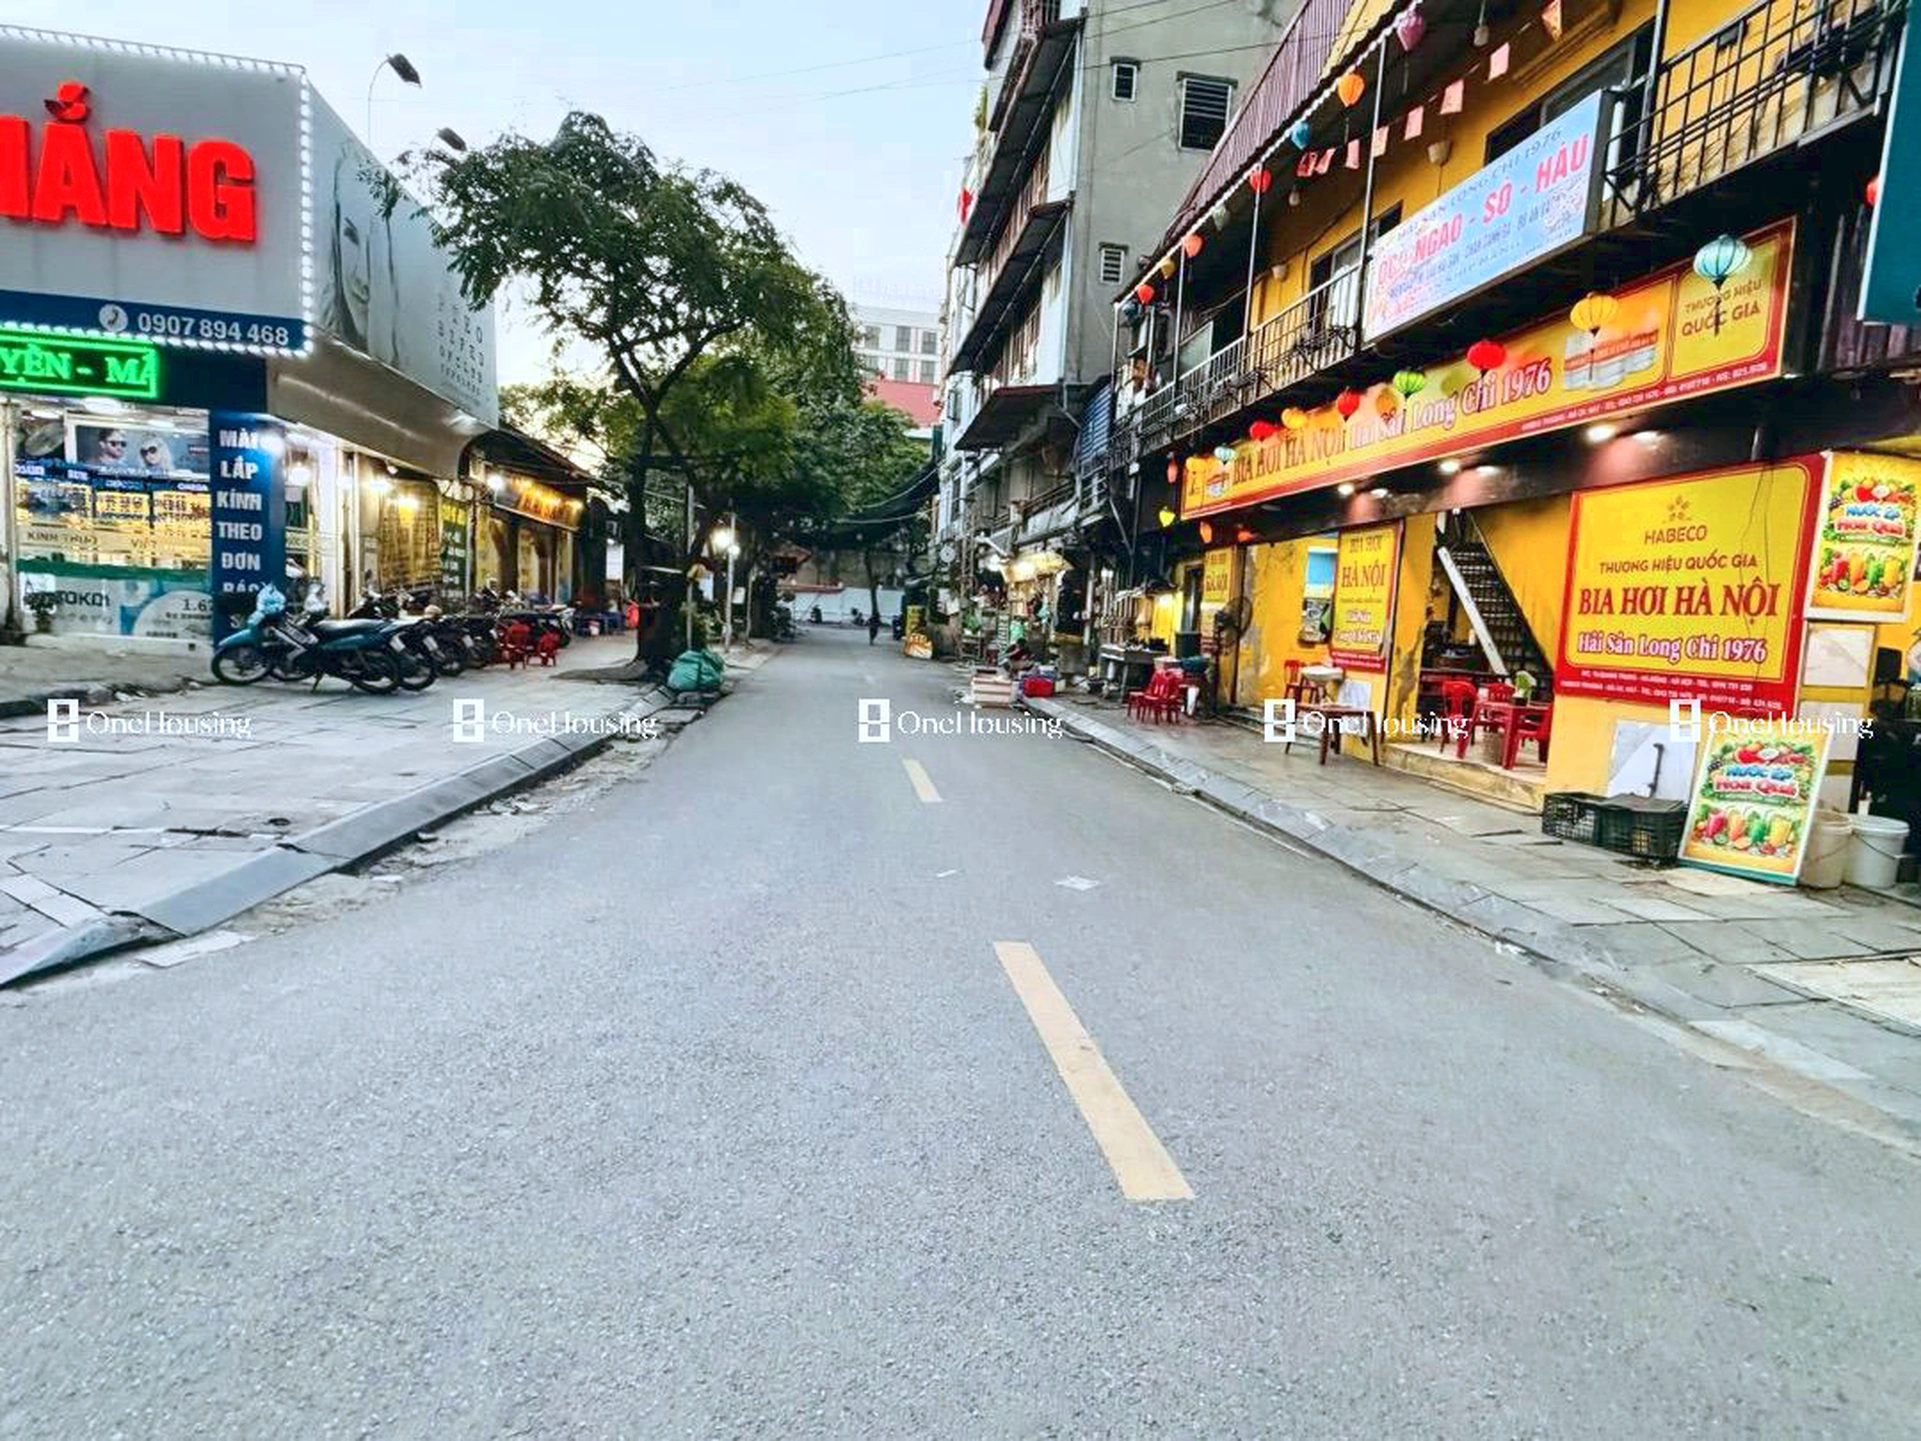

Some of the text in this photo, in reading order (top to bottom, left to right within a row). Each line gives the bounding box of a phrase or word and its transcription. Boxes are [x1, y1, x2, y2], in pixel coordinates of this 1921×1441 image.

[1412, 212, 1464, 265] NGAO
[1732, 300, 1761, 320] GIA
[138, 312, 289, 346] 0907 894 468
[1411, 393, 1458, 430] Long
[1501, 357, 1552, 404] 1976
[217, 488, 262, 511] KÍNH
[217, 521, 262, 541] THEO
[1643, 524, 1708, 546] HABECO
[1731, 553, 1758, 569] GIA
[1577, 575, 1781, 625] BIA HƠI HÀ NỘI
[1636, 634, 1682, 664] Long
[1686, 634, 1719, 660] Chi
[1721, 638, 1767, 664] 1976
